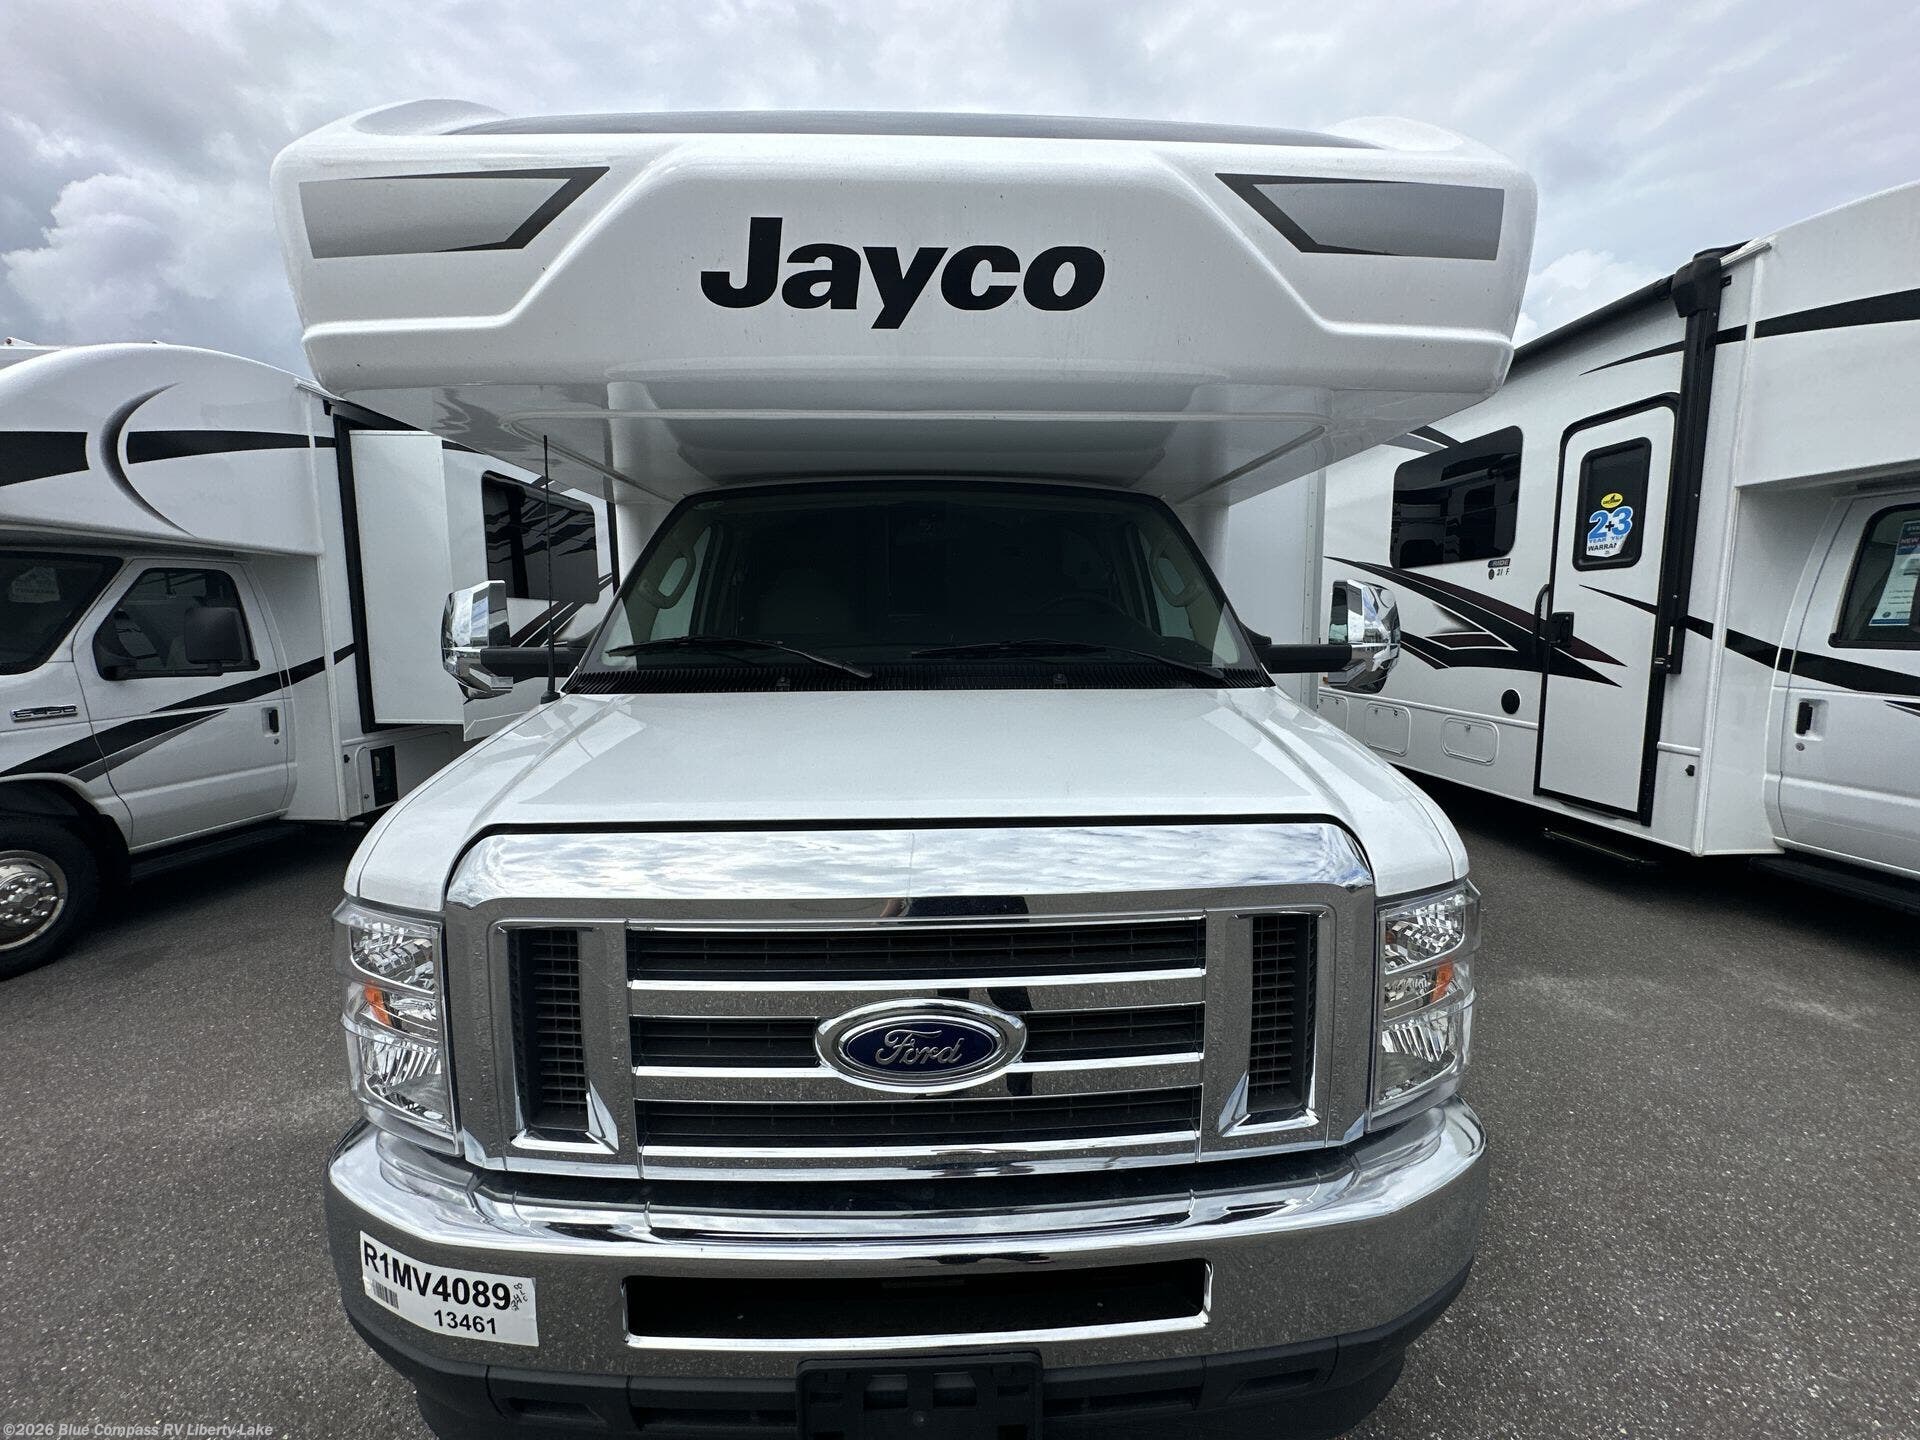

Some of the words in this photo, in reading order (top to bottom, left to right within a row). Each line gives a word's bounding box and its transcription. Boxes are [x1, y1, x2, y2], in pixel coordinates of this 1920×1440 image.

[701, 217, 1105, 329] Jayco
[875, 1029, 965, 1065] Ford
[364, 1240, 511, 1311] R1MV4089
[434, 1309, 497, 1335] 13461
